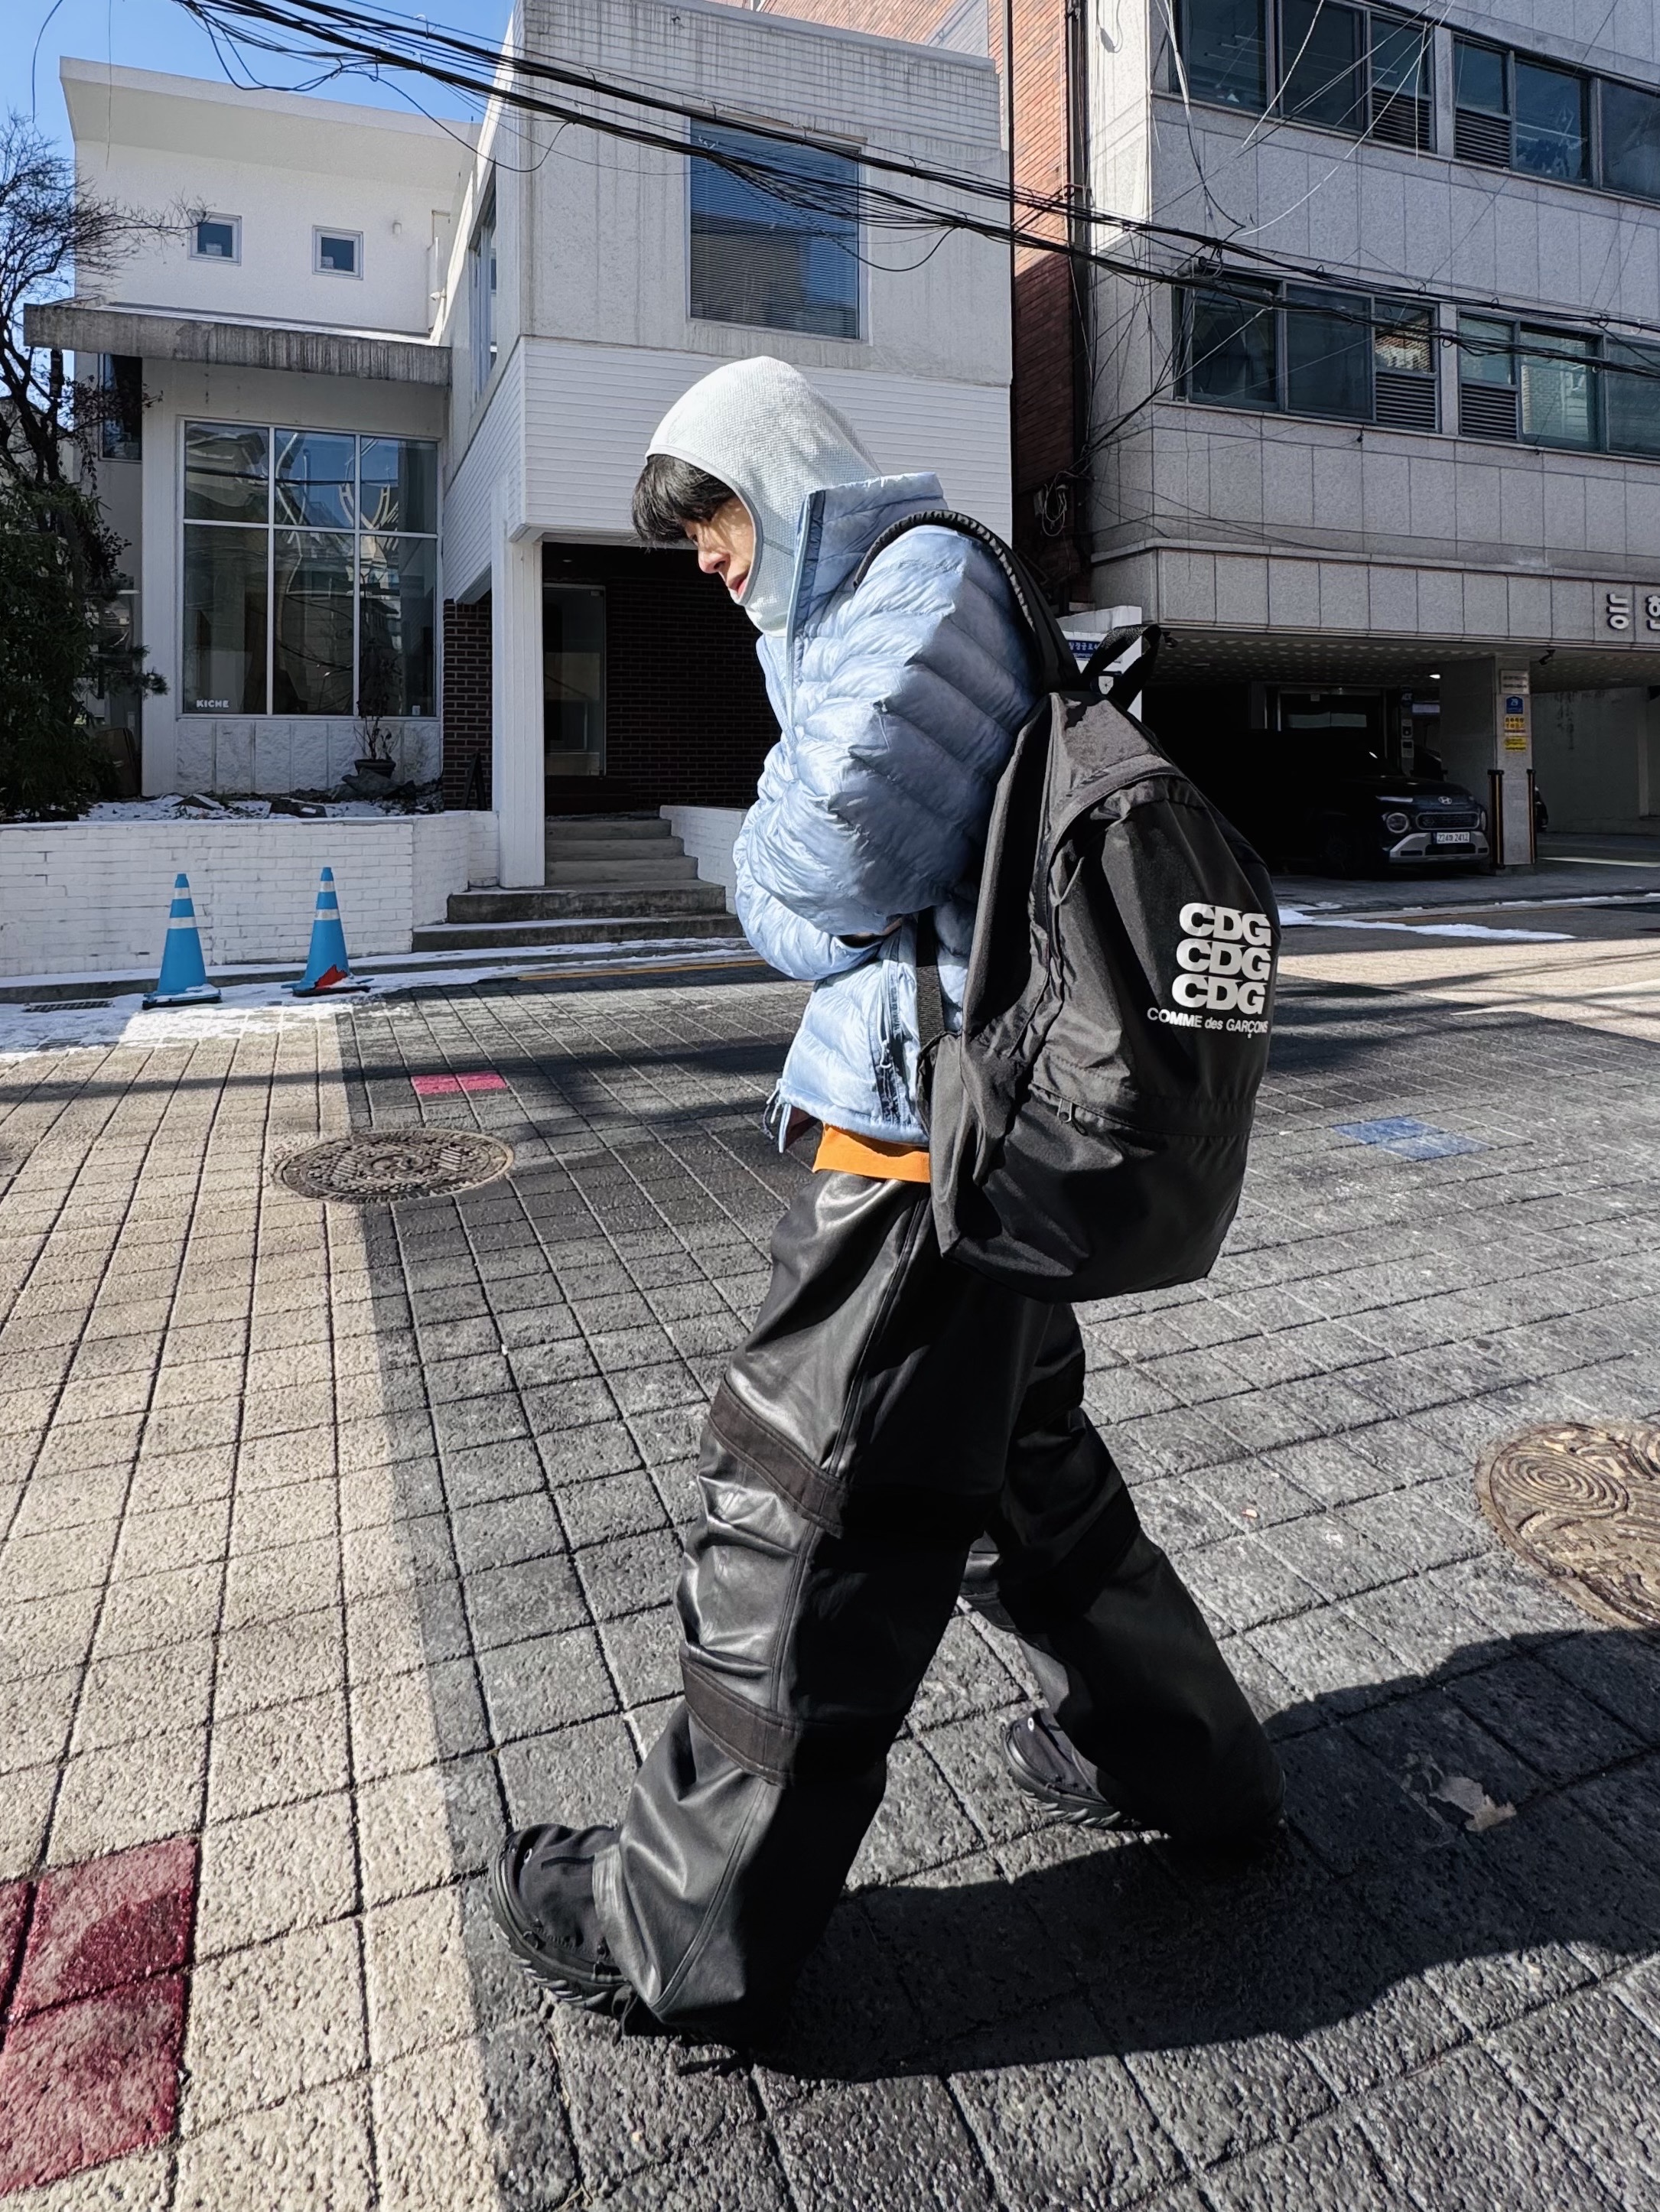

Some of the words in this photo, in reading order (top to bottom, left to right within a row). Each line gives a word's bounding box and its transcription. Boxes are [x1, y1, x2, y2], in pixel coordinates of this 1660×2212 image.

[196, 699, 229, 708] KICHE
[1179, 903, 1272, 947] CDG
[1176, 938, 1271, 981] CDG
[1171, 973, 1268, 1015] CDG
[1147, 1007, 1203, 1028] COMME
[1204, 1016, 1224, 1030] des
[1225, 1018, 1269, 1039] GARÇONS
